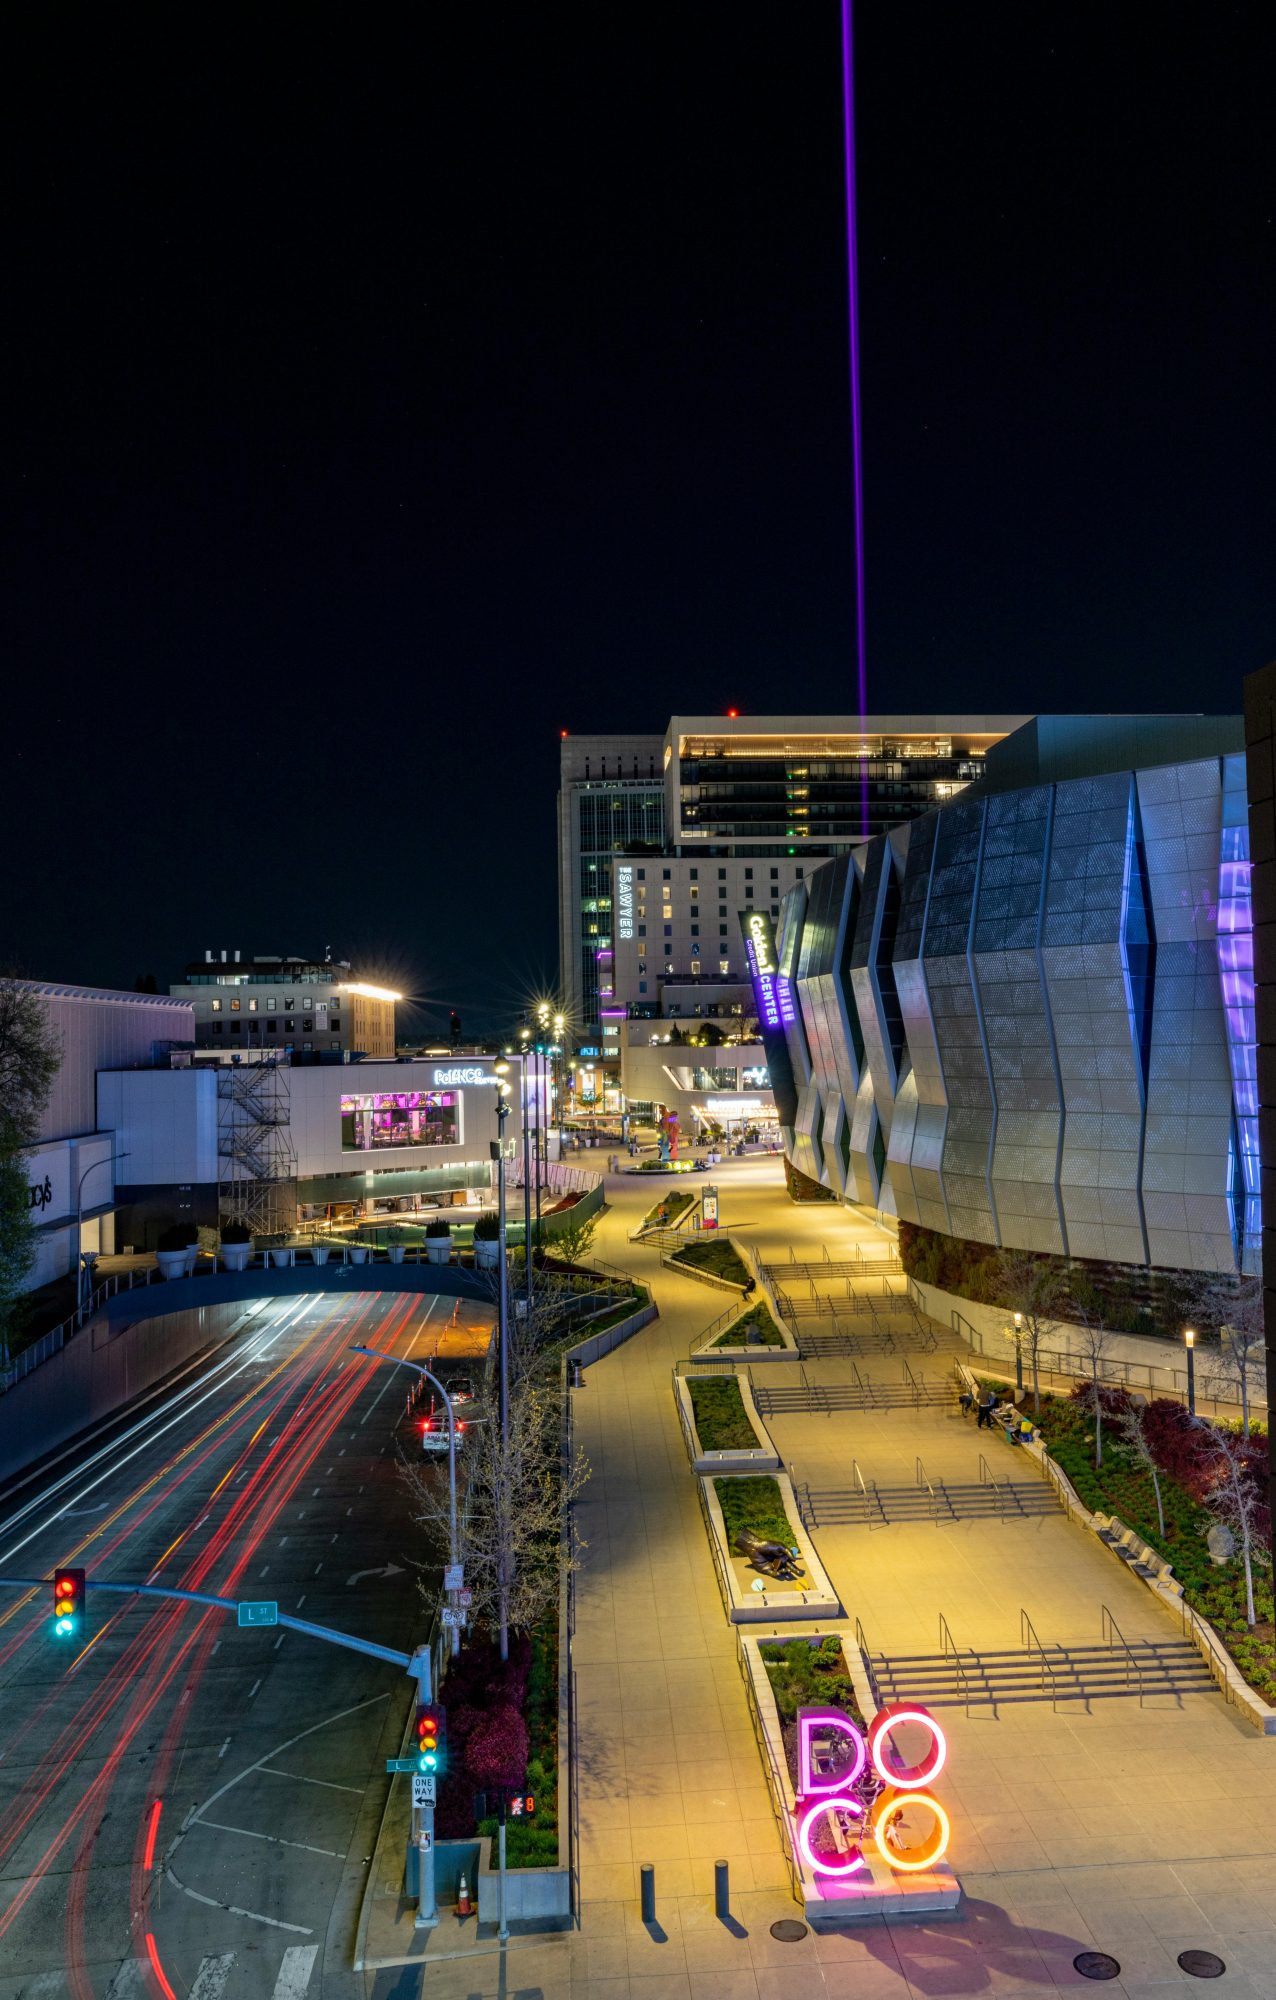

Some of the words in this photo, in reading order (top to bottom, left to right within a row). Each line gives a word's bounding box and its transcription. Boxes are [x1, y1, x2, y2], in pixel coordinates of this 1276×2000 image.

[620, 874, 632, 938] SAWYER
[746, 939, 755, 959] Credit
[760, 975, 779, 1025] CENTER
[248, 1608, 255, 1620] L
[260, 1607, 267, 1615] ST
[395, 1762, 400, 1770] L
[415, 1779, 432, 1787] ONE
[414, 1788, 433, 1796] WAY
